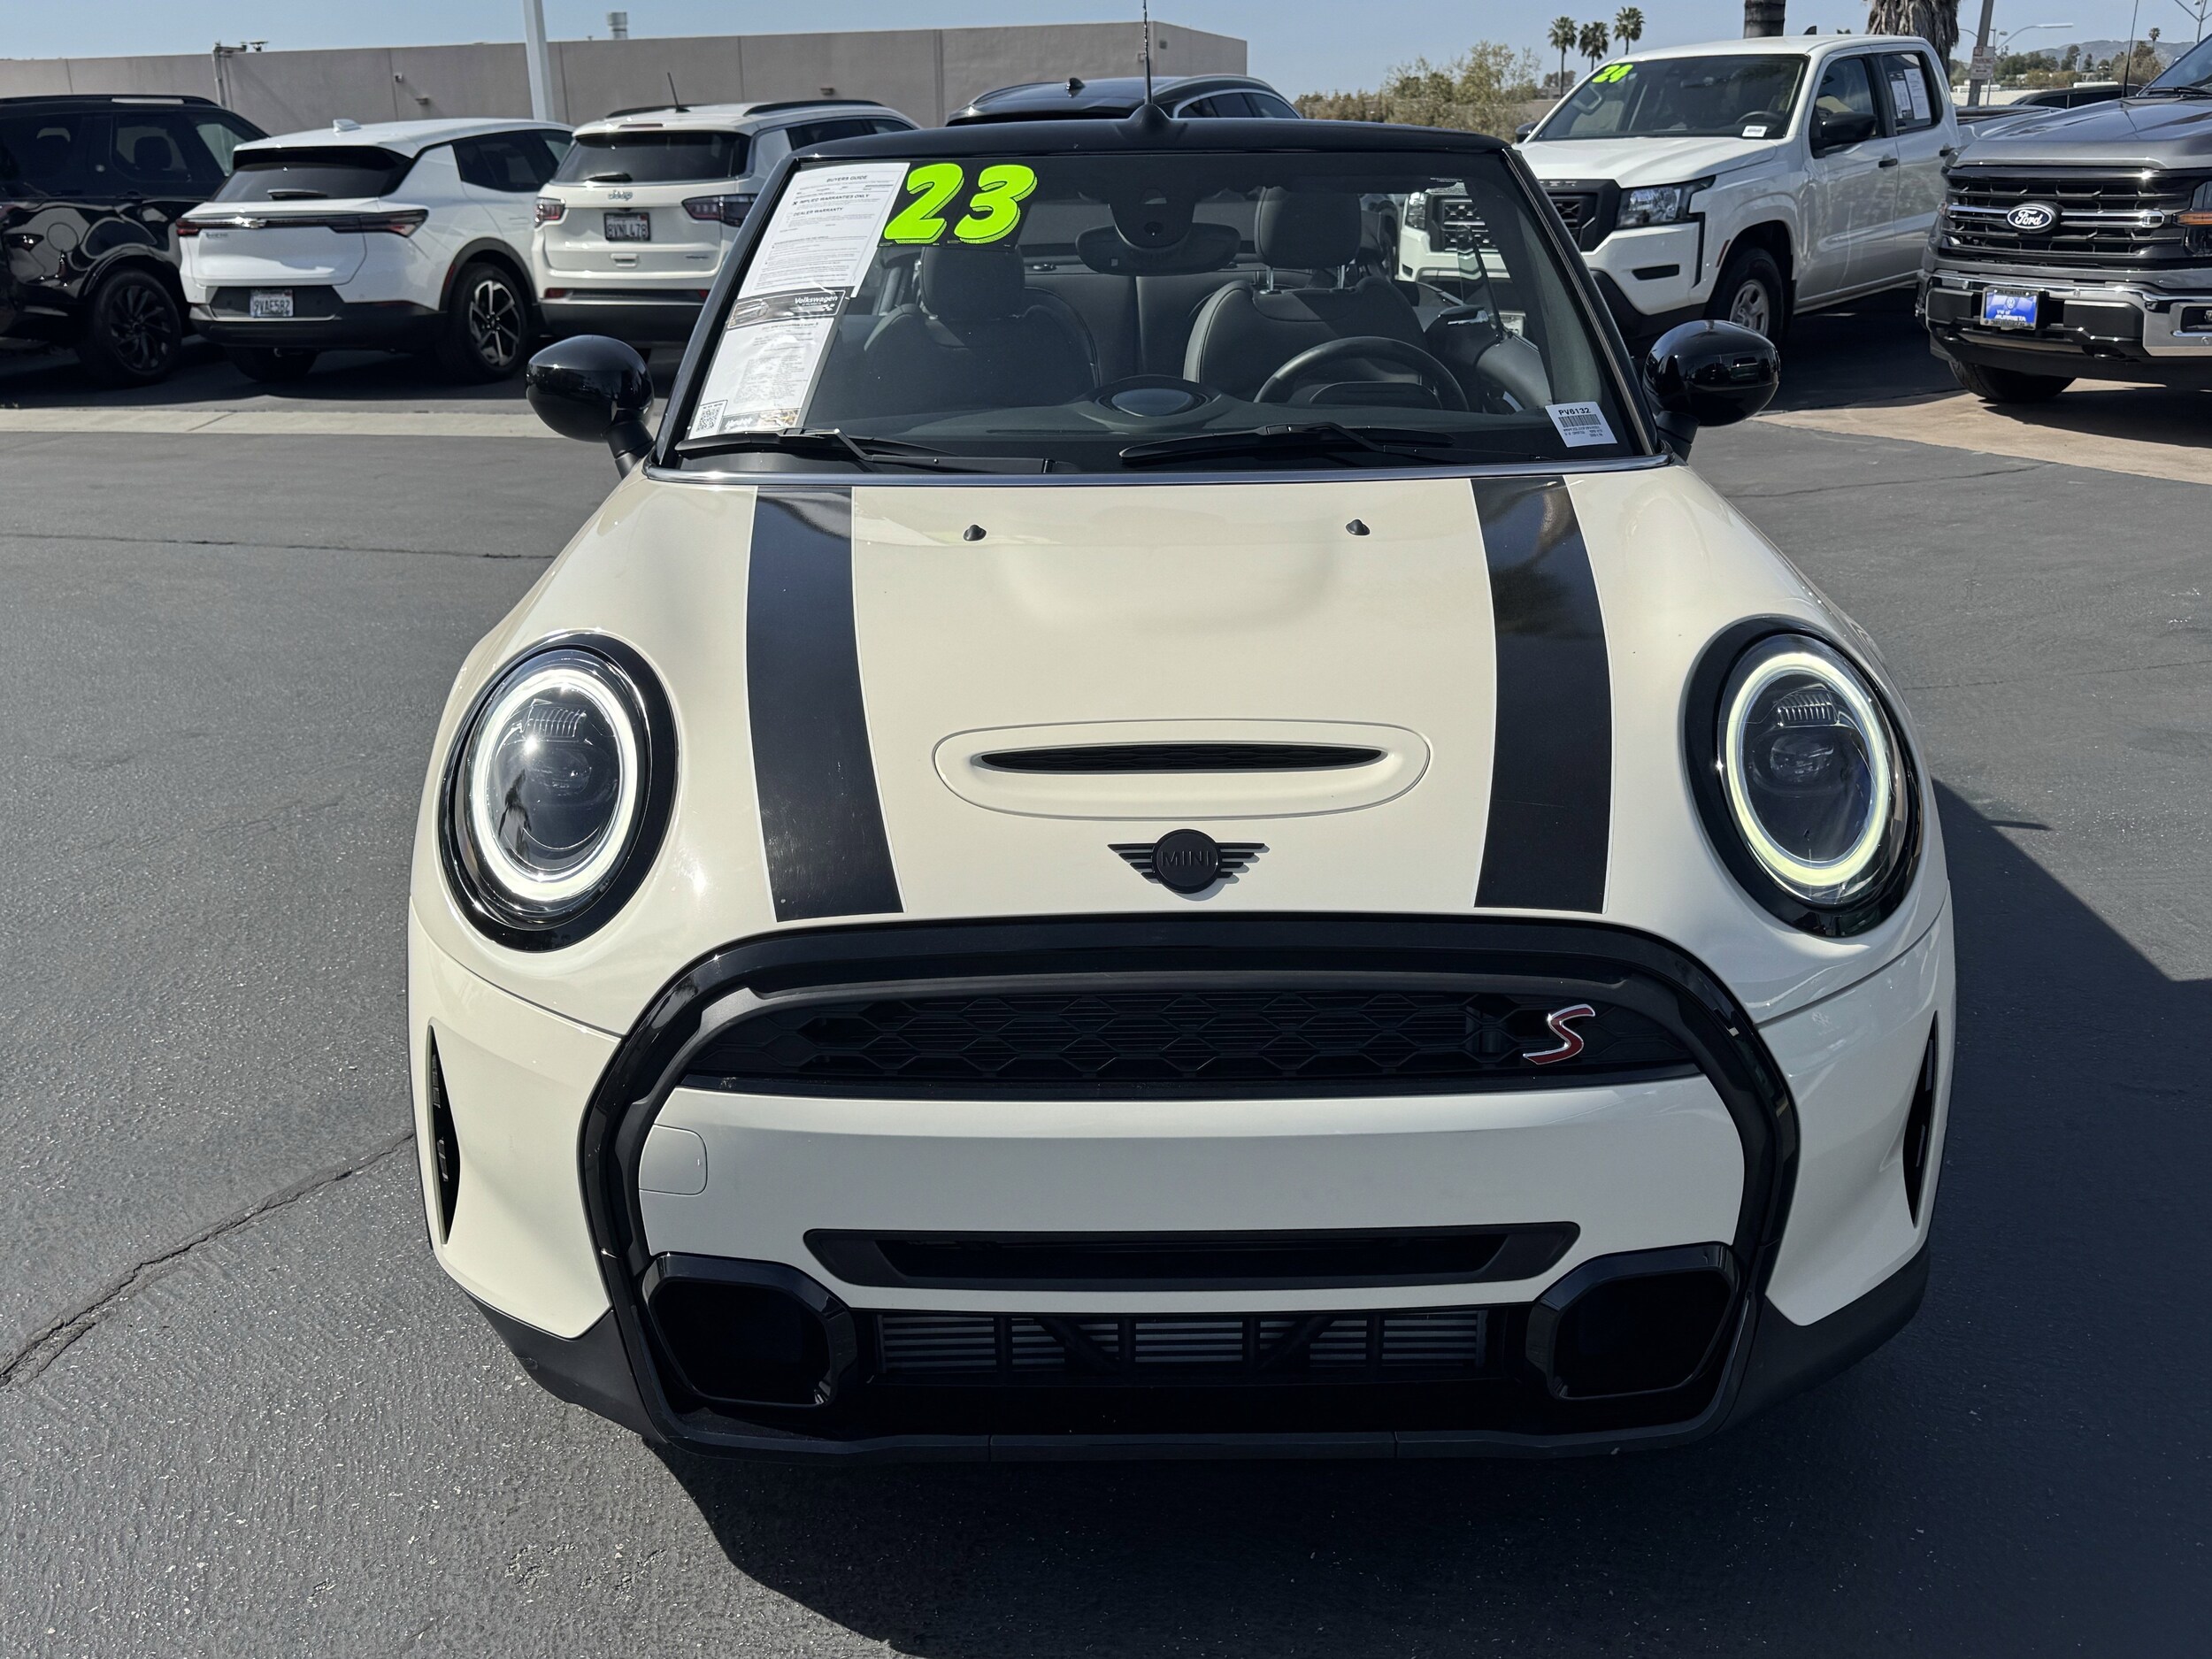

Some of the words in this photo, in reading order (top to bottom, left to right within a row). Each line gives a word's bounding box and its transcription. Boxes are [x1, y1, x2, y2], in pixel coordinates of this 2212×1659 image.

[884, 163, 1038, 244] 23
[2015, 209, 2044, 226] Ford
[795, 296, 839, 304] Volkswagen
[1161, 850, 1211, 866] MINI
[1523, 1003, 1595, 1065] S
